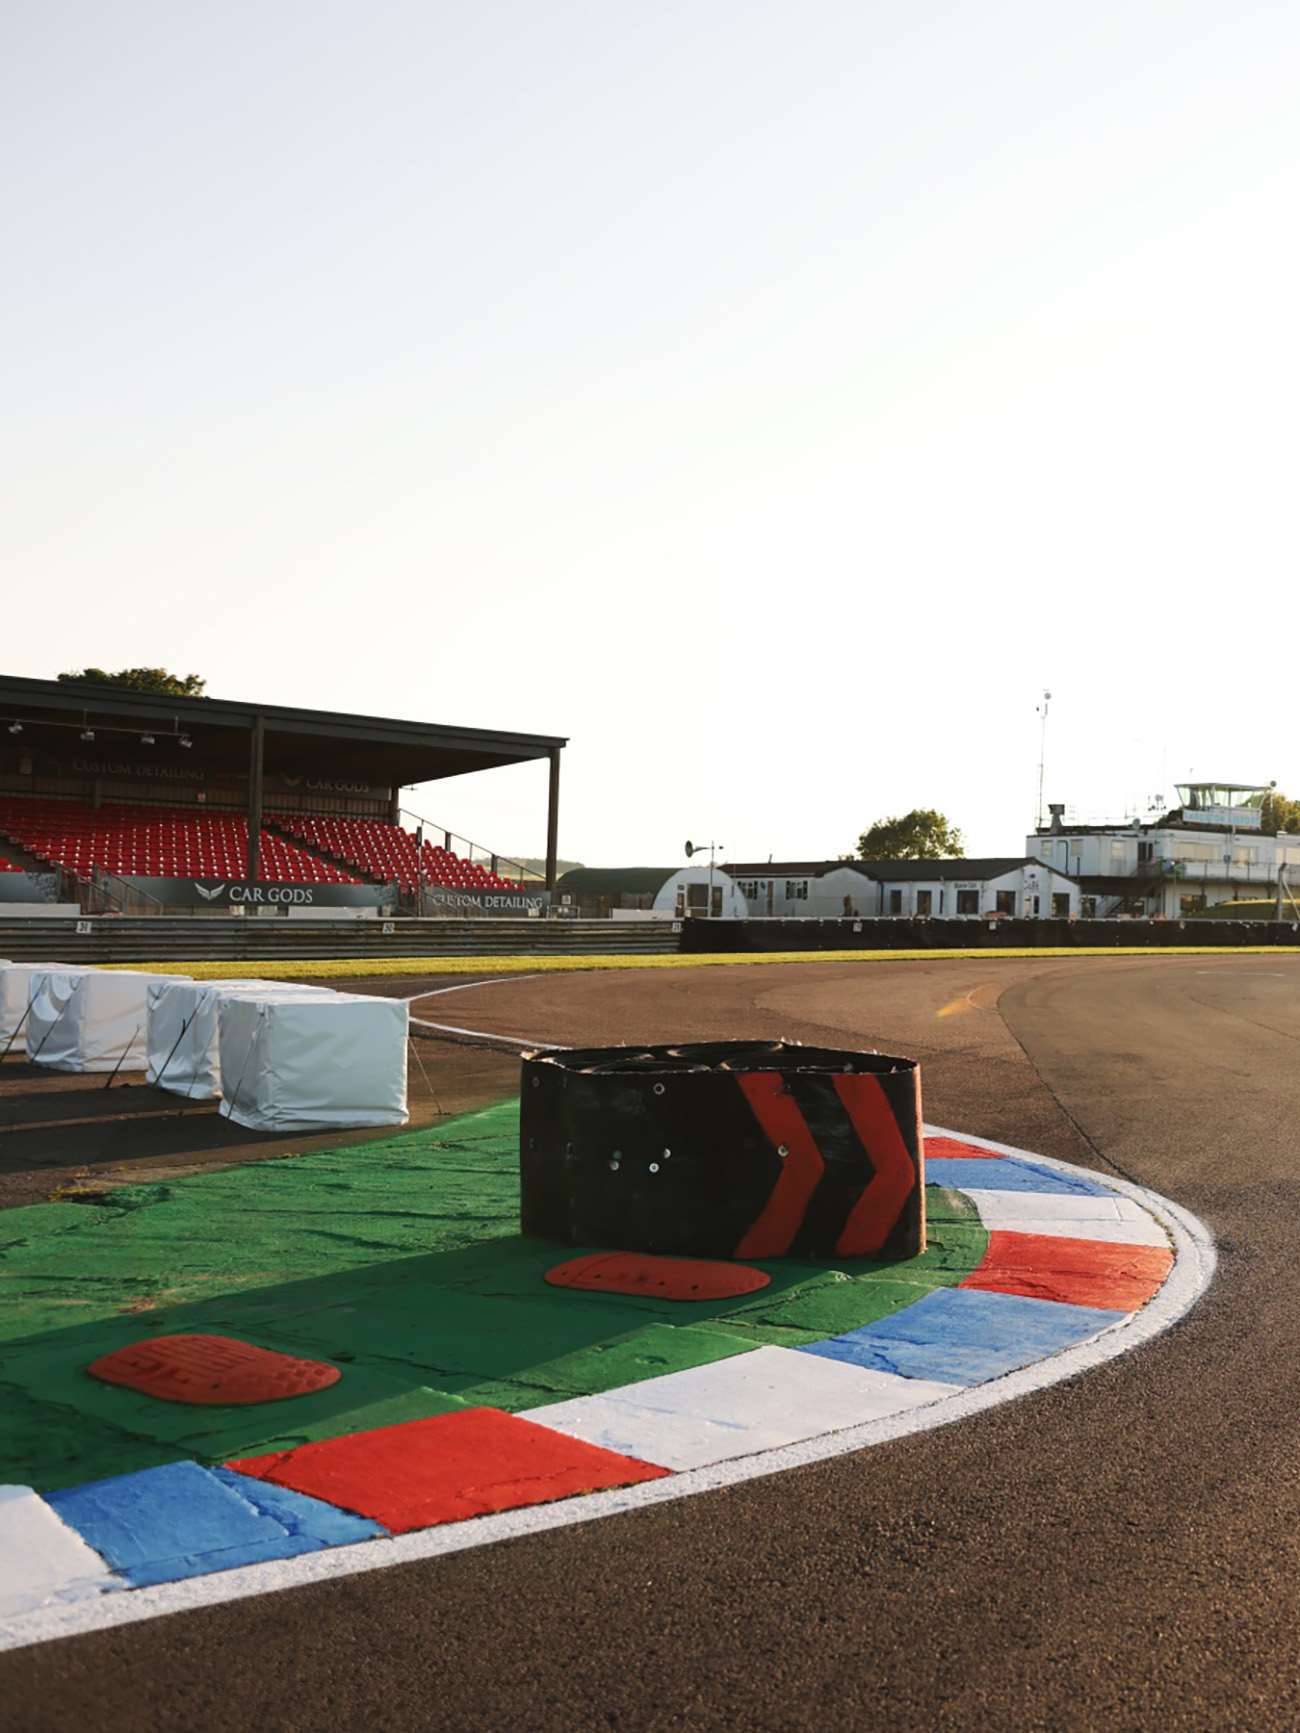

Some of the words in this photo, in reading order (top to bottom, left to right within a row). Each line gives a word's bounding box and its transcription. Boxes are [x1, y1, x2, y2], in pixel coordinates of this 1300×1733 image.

[229, 886, 265, 902] CAR
[267, 887, 313, 903] GODS
[431, 894, 481, 907] CUSTOM
[484, 895, 543, 910] DETAILING
